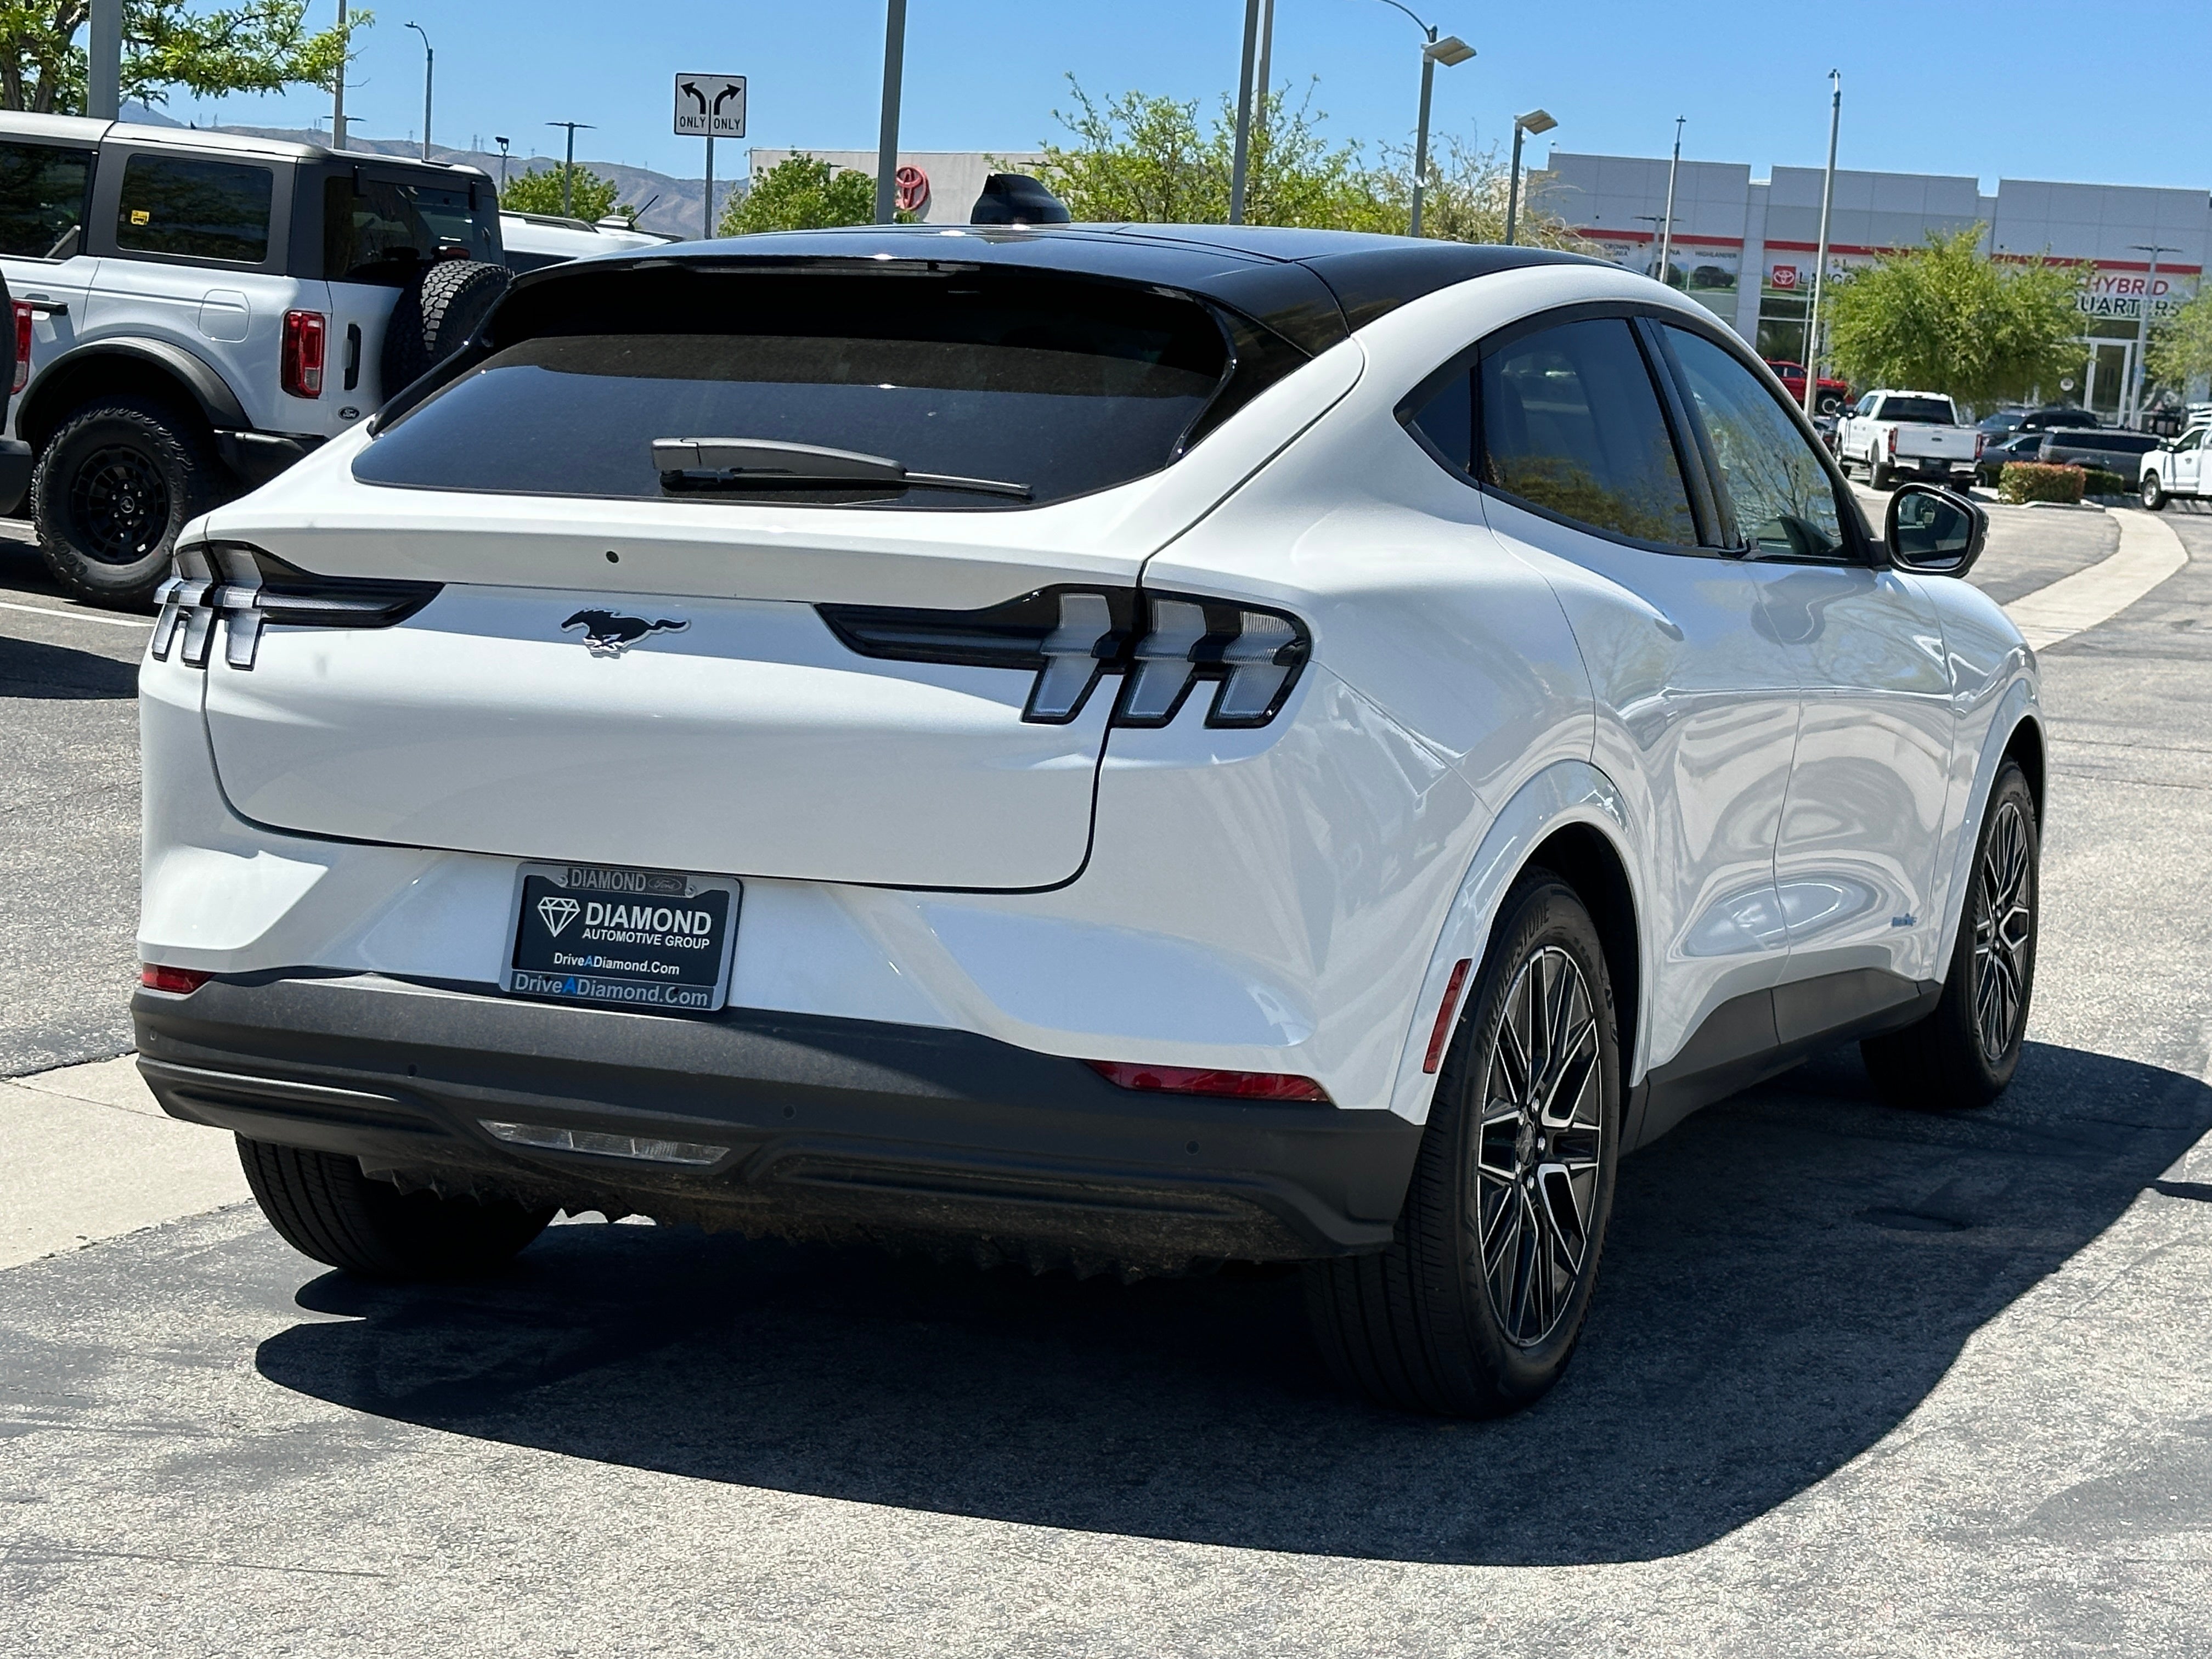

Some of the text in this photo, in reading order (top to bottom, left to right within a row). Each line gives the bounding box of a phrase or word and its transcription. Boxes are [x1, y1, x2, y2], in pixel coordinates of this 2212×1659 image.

[680, 116, 706, 128] ONLY
[714, 117, 741, 130] ONLY
[2072, 296, 2180, 317] UARTRS
[571, 868, 676, 892] DIAMOND Ford
[585, 902, 712, 935] DIAMOND
[582, 928, 710, 950] AUTOMOTIVE GROUP
[554, 952, 680, 975] DriveADiamond.Com
[515, 974, 708, 1006] DriveADiamond.Com
